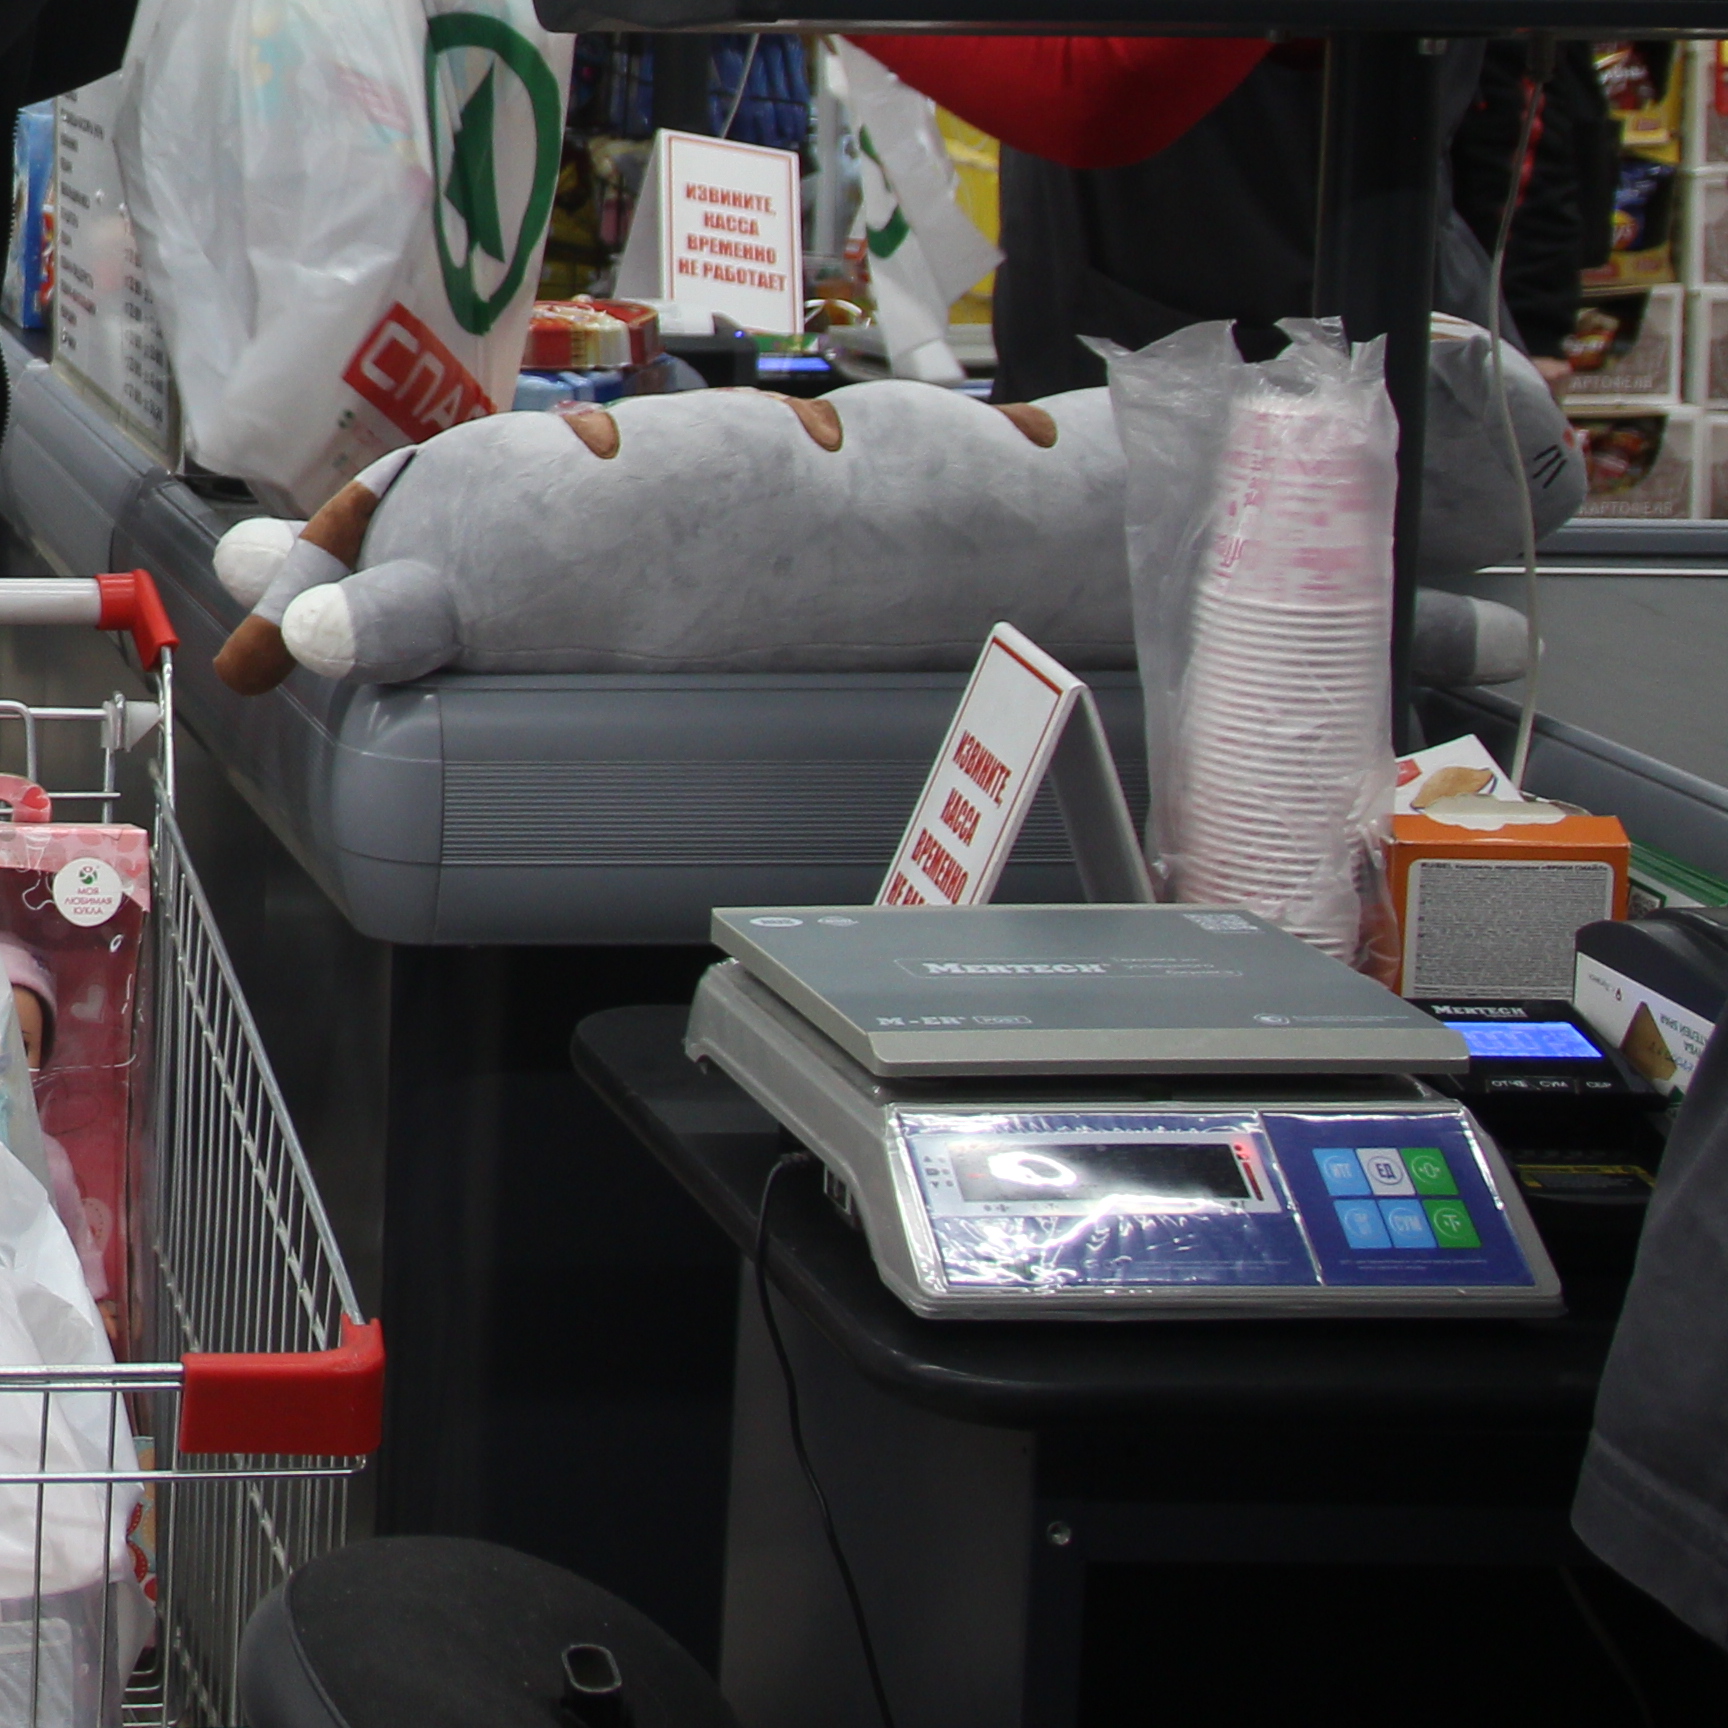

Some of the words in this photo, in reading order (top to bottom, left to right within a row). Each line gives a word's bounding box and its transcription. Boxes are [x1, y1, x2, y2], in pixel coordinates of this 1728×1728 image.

[686, 183, 776, 216] ИЗВИНИТЕ,
[704, 211, 760, 236] КАССА
[687, 233, 777, 265] ВРЕМЕННО
[679, 258, 698, 277] НЕ
[703, 262, 787, 292] РАБОТАЕТ
[940, 786, 982, 848] КАССА
[910, 826, 969, 905] ВРЕМЕННО
[928, 962, 1107, 975] MERTECH
[1431, 1005, 1527, 1016] MERTECH
